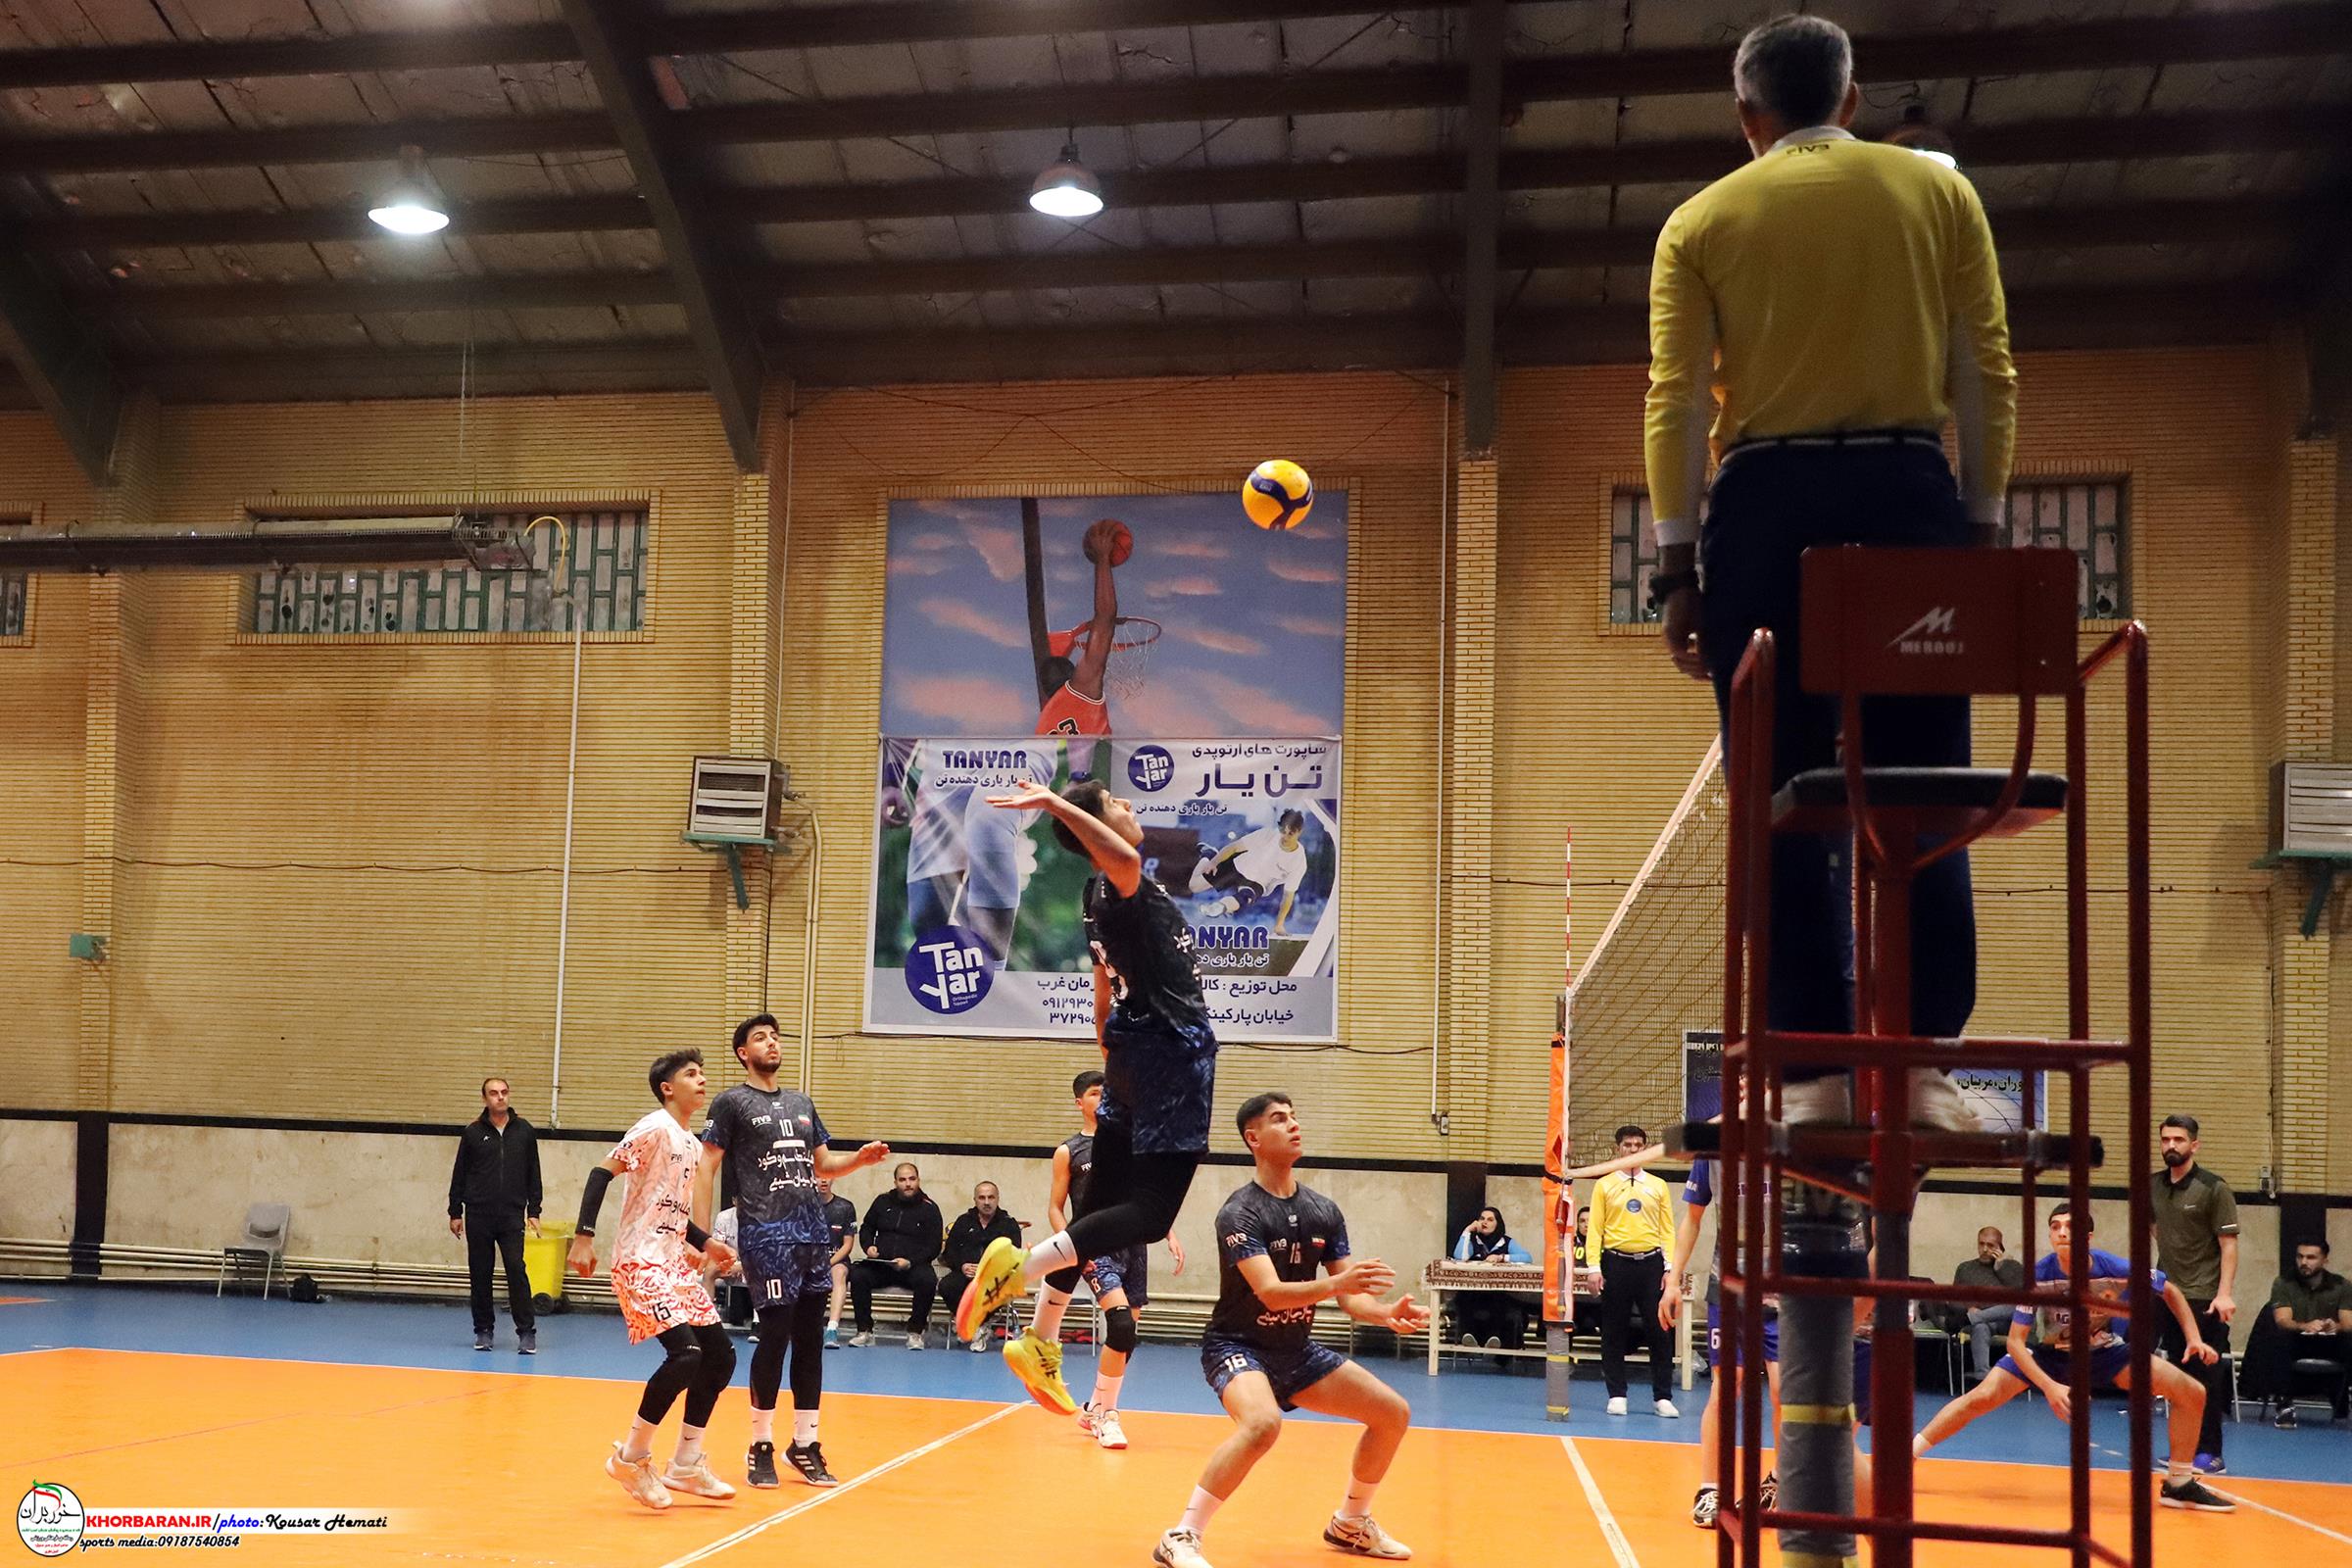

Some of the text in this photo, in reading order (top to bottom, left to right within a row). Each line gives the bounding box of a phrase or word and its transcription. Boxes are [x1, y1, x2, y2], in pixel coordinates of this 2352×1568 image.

[1047, 717, 1080, 735] 3
[942, 750, 1027, 769] TANYAR
[1192, 743, 1327, 760] ساپورت های ارتوپدی
[1135, 754, 1169, 770] Tan
[1195, 762, 1323, 798] تن یار
[1188, 925, 1269, 949] ANYAR
[918, 941, 984, 973] Tan
[1229, 979, 1267, 998] توزیع
[1268, 980, 1298, 995] محل
[1042, 997, 1095, 1008] ۰۹۱۲۹۳۰
[1252, 1008, 1294, 1024] خیابان
[778, 1118, 795, 1137] 10
[1081, 1161, 1093, 1172] FIV
[765, 1278, 783, 1300] 10
[652, 1301, 672, 1323] 15
[1224, 1352, 1249, 1373] 16
